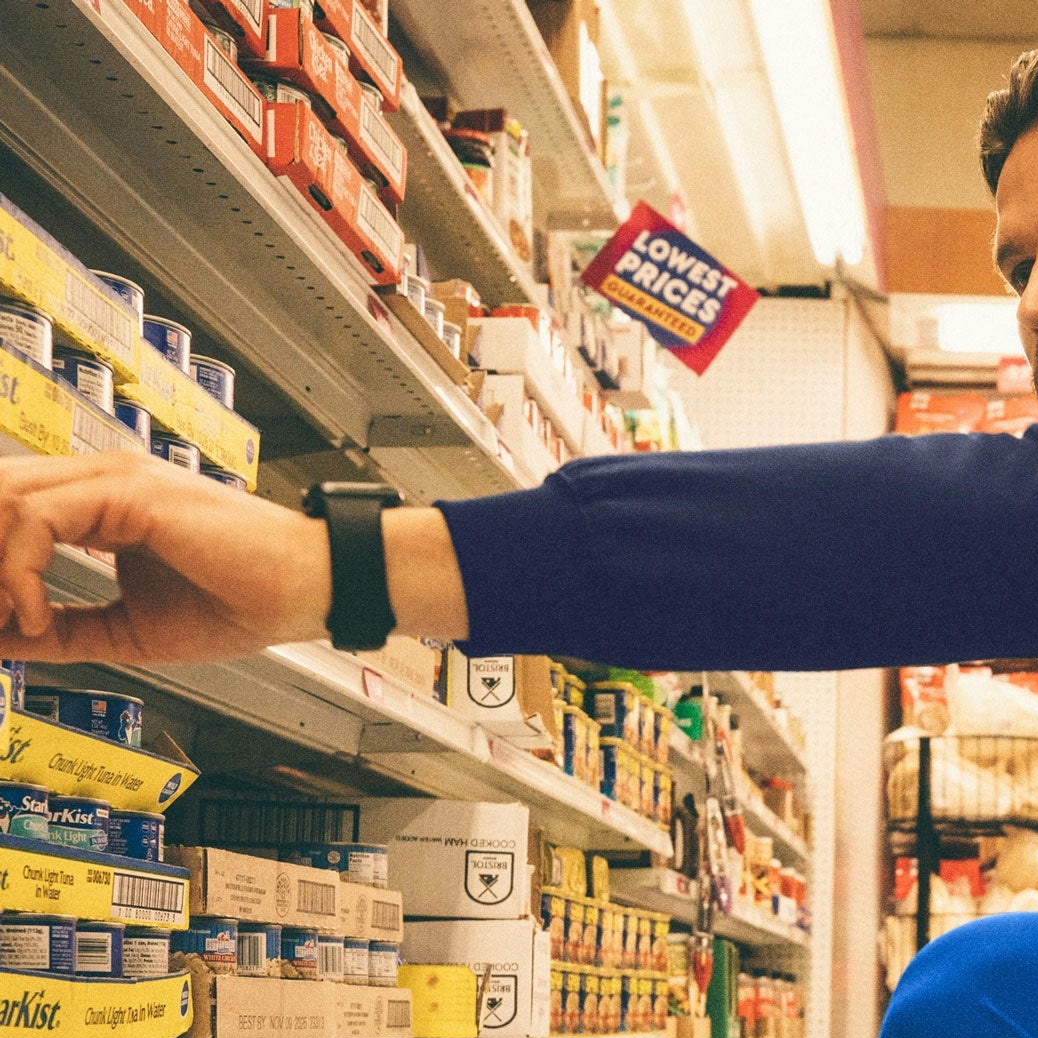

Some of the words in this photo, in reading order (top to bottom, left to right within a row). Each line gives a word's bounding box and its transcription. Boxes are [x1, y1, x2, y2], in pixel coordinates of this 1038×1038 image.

[632, 229, 739, 299] LOWEST
[614, 249, 722, 325] PRICES
[606, 280, 698, 339] GUARANTEED
[472, 663, 509, 672] BRISTOL
[48, 752, 75, 776] Chunk
[74, 757, 97, 783] Light
[96, 764, 112, 786] Tuna
[121, 771, 144, 792] Water
[64, 831, 87, 844] Light
[443, 837, 468, 848] HAM
[470, 838, 515, 849] COOKED
[470, 860, 507, 869] BRISTOL
[23, 865, 44, 881] Chunk
[44, 870, 60, 887] Light
[59, 870, 74, 886] Tuna
[42, 888, 61, 901] Water
[85, 1007, 108, 1026] Chunk
[107, 1006, 127, 1030] Light
[147, 1002, 167, 1019] Water
[238, 1014, 257, 1031] BEST
